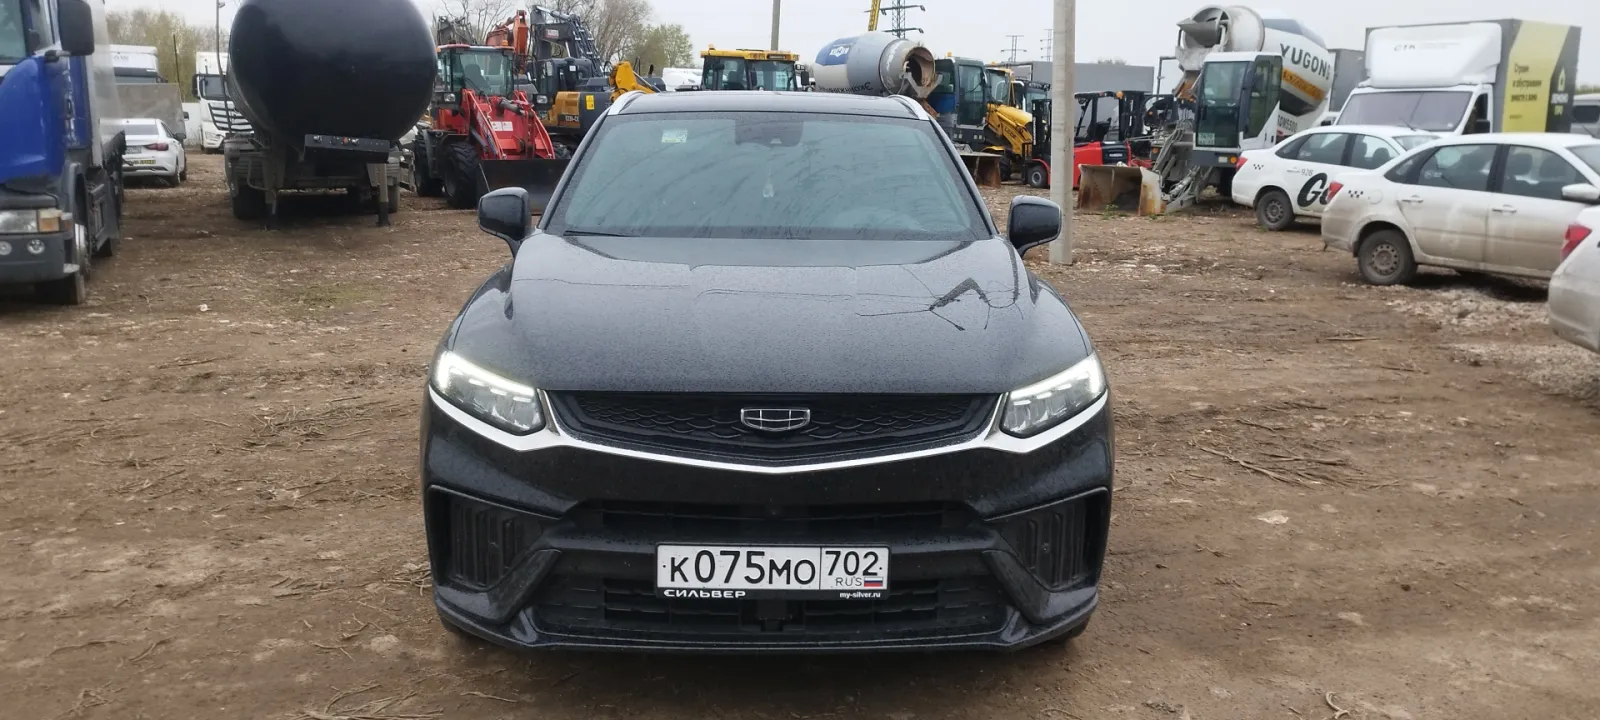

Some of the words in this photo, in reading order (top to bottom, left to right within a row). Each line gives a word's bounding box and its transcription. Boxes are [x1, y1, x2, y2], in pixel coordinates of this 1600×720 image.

[825, 551, 879, 576] 702
[835, 577, 863, 587] RUS
[664, 589, 746, 598] СИЛЬВЕР
[839, 591, 881, 599] my-silver.ru
